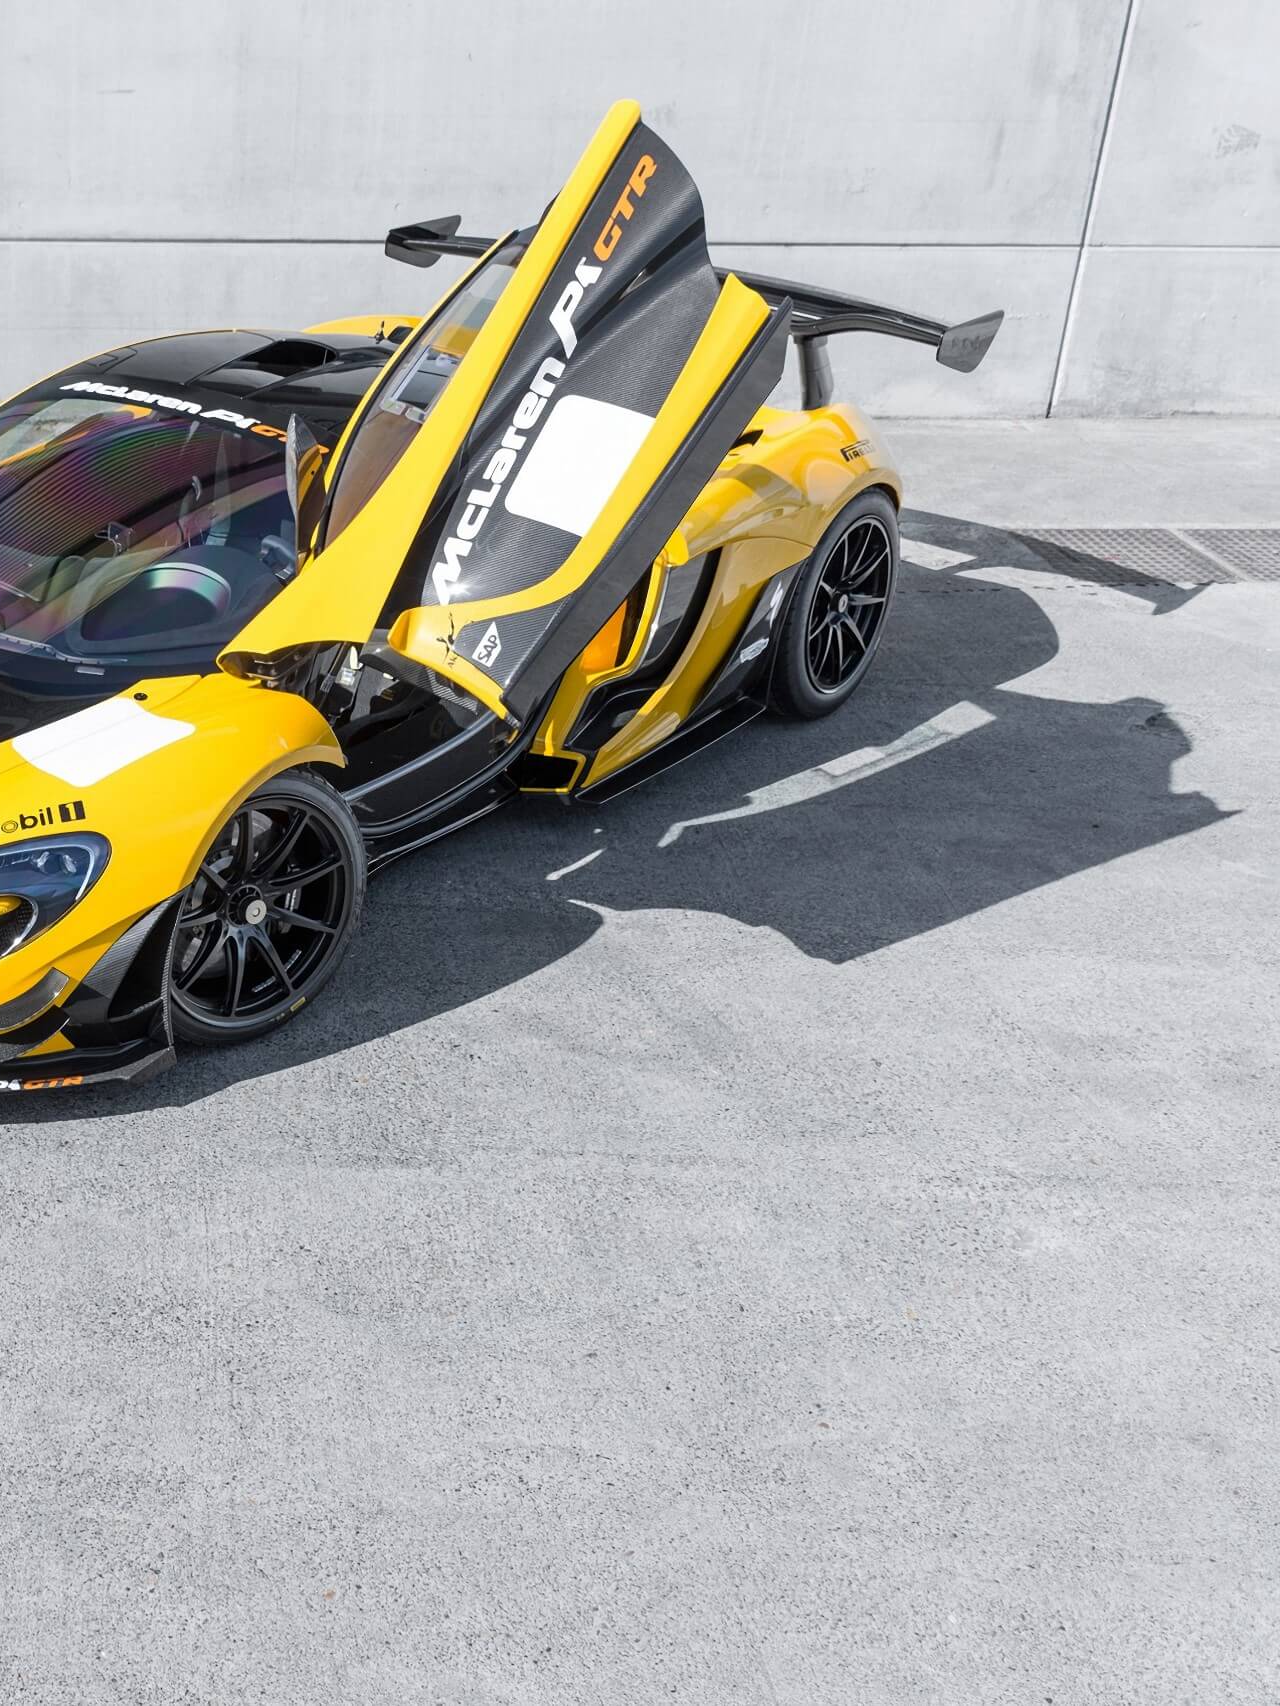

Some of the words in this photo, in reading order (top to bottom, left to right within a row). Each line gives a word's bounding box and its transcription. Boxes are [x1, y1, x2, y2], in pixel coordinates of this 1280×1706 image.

[431, 356, 566, 606] McLaren
[594, 154, 658, 262] GTR
[60, 381, 203, 415] McLaren
[840, 439, 877, 462] PIRE
[476, 634, 499, 664] SAP
[23, 1076, 84, 1090] GTR
